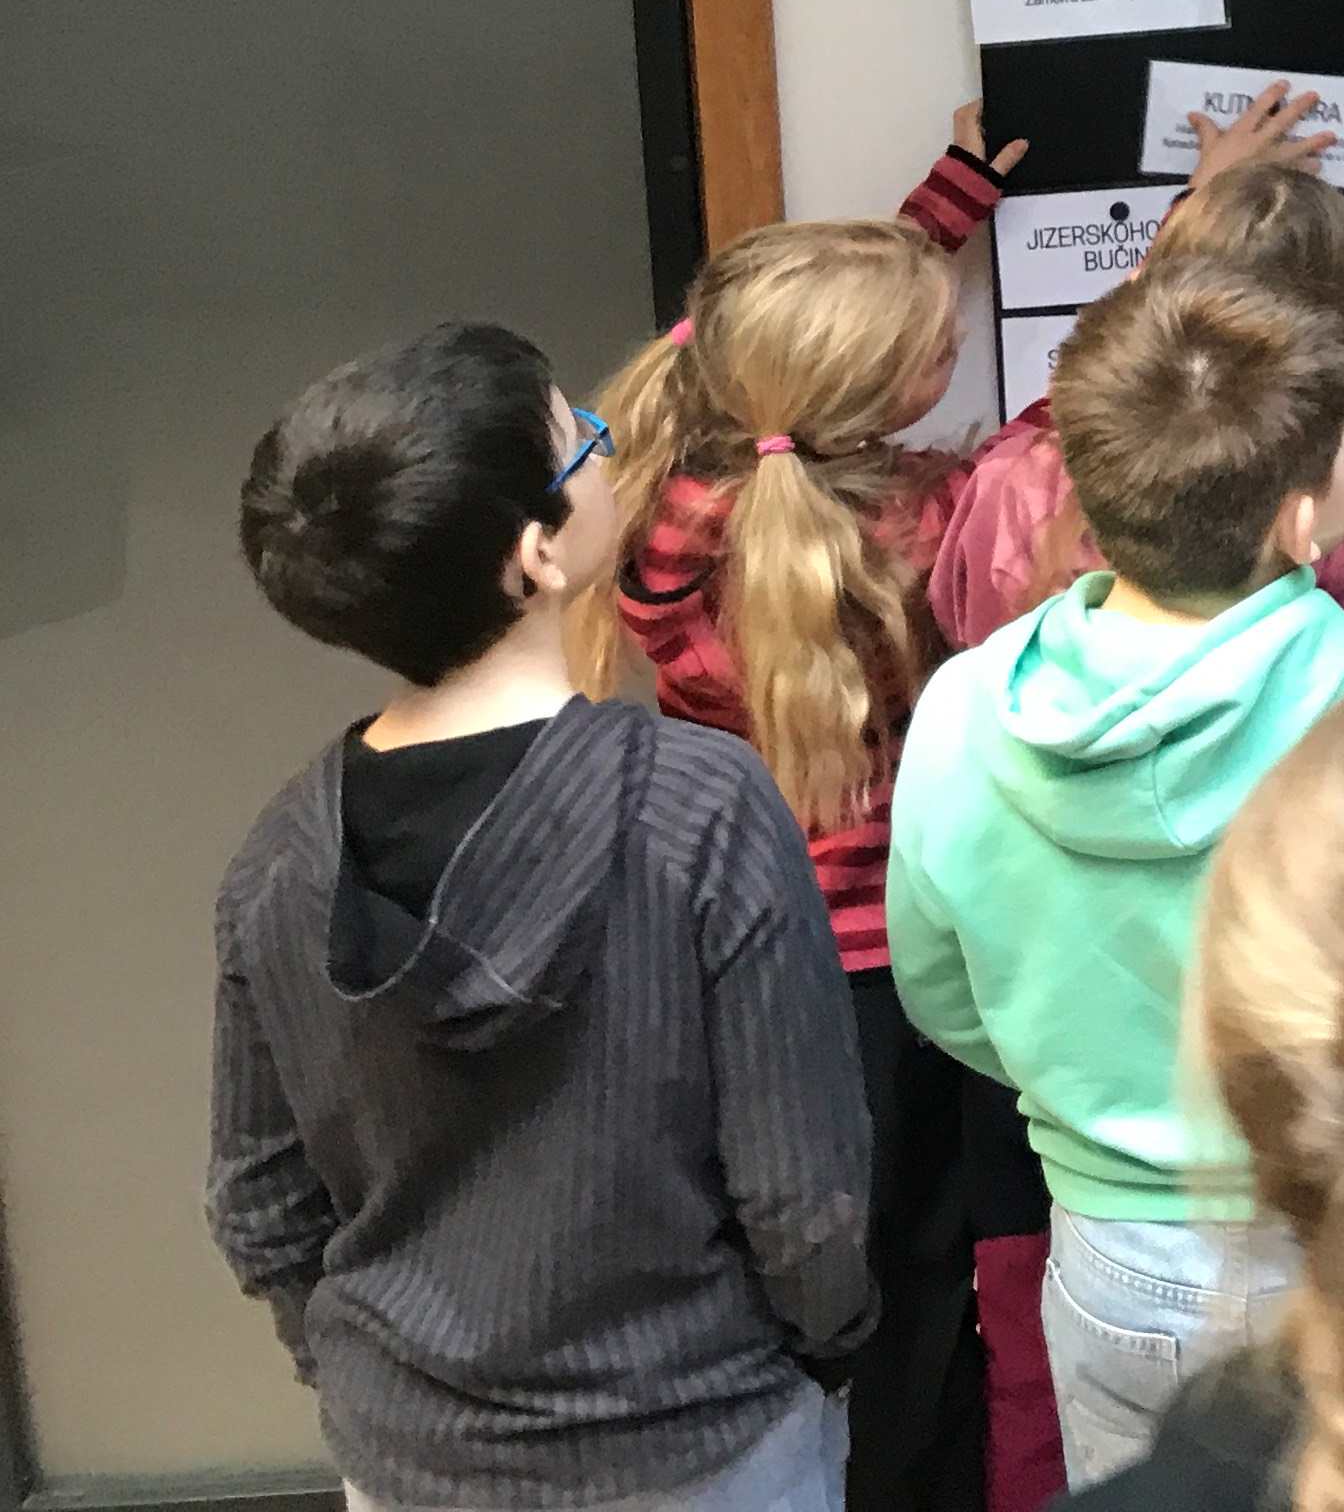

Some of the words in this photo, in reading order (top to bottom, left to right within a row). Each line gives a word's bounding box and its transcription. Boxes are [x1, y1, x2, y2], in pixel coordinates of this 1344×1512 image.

[1204, 92, 1255, 115] KUT
[1027, 219, 1160, 250] JIZERSKOHO
[1084, 245, 1152, 272] BUČIN
